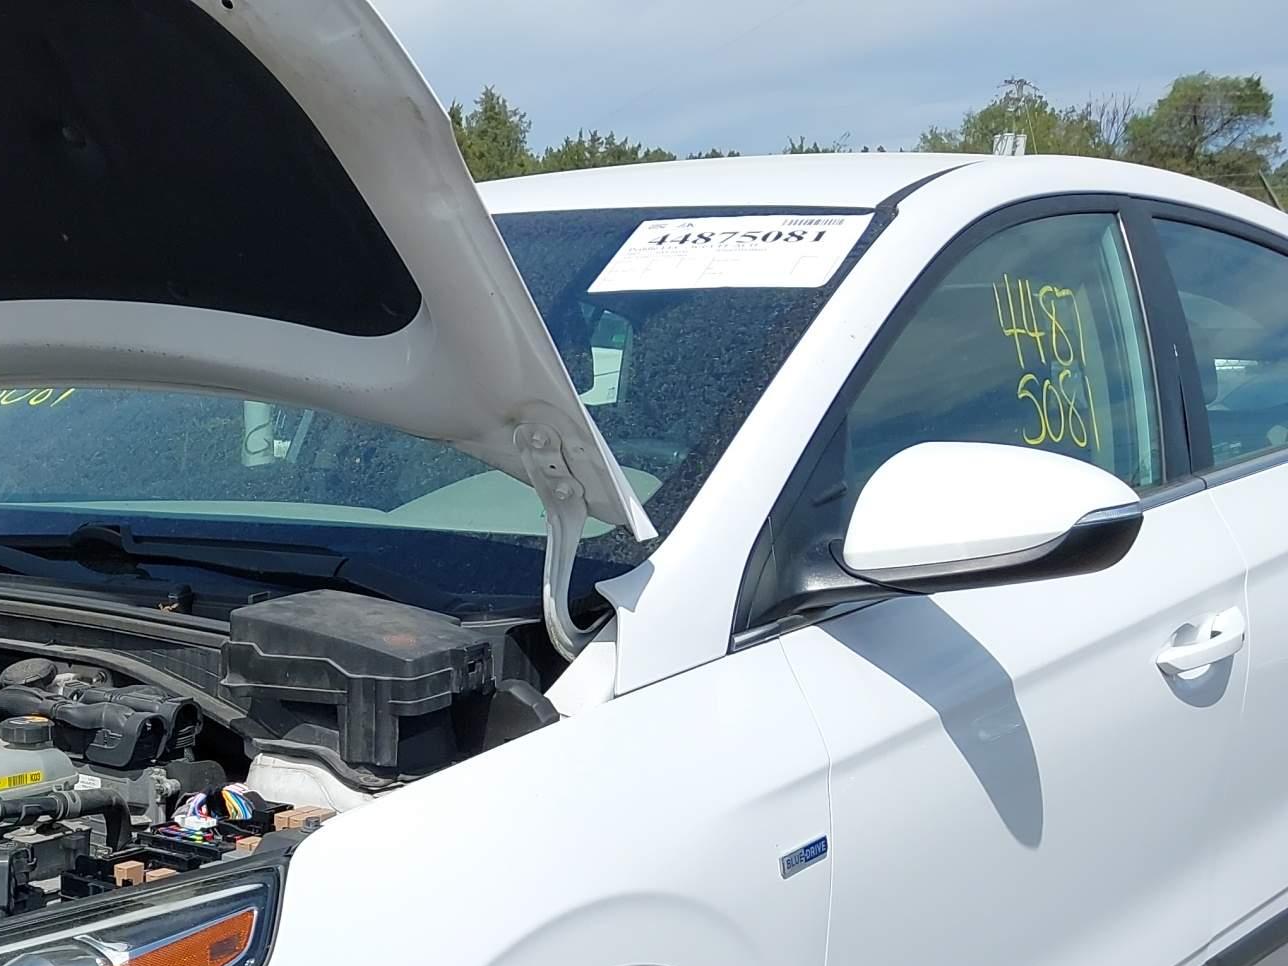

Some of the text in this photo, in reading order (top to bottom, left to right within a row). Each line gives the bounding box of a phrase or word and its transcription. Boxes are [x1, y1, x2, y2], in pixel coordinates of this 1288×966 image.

[648, 229, 828, 246] 44875081
[992, 273, 1087, 370] 4487
[1017, 369, 1100, 452] 5081
[805, 840, 827, 860] DRIVE
